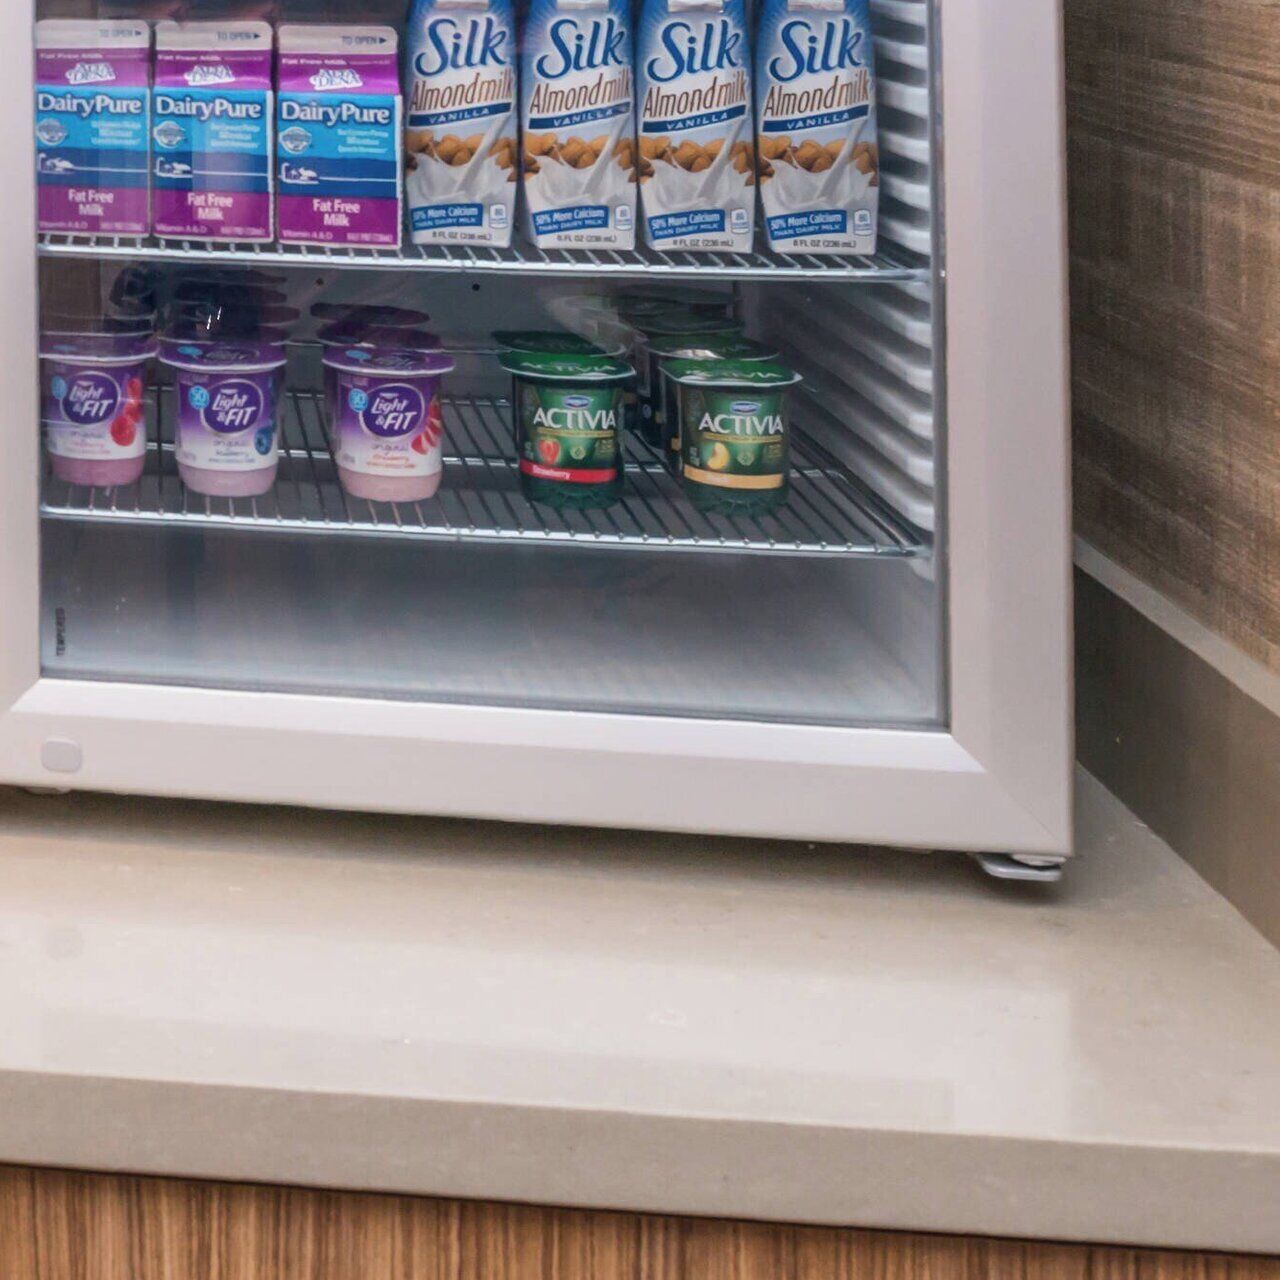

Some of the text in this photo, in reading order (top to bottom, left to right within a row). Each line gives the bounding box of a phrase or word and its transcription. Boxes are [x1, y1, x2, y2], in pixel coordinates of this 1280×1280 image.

[415, 17, 507, 77] Silk
[536, 18, 625, 79] Silk
[647, 19, 740, 82] Silk
[769, 19, 862, 82] Silk
[409, 69, 512, 111] Almondmilk
[529, 68, 630, 114] Almondmilk
[643, 70, 746, 118] Almondmilk
[763, 69, 869, 117] Almondmilk
[38, 93, 142, 118] DairyPure
[156, 96, 262, 121] DairyPure
[281, 101, 390, 126] DairyPure
[429, 107, 490, 124] VANILLA
[553, 110, 614, 127] VANILLA
[666, 112, 728, 130] VANILLA
[787, 112, 850, 130] VANILLA
[68, 189, 114, 203] Fat Free
[187, 192, 233, 207] Fat Free
[312, 198, 361, 213] Fat Free
[79, 203, 104, 216] Milk
[198, 206, 224, 220] Milk
[323, 213, 350, 227] Milk
[69, 385, 105, 402] Light
[212, 394, 248, 411] Light
[371, 398, 408, 414] Light
[533, 407, 616, 430] ACTIVIA
[698, 412, 784, 435] ACTIVIA
[55, 607, 66, 657] TEMPERED
